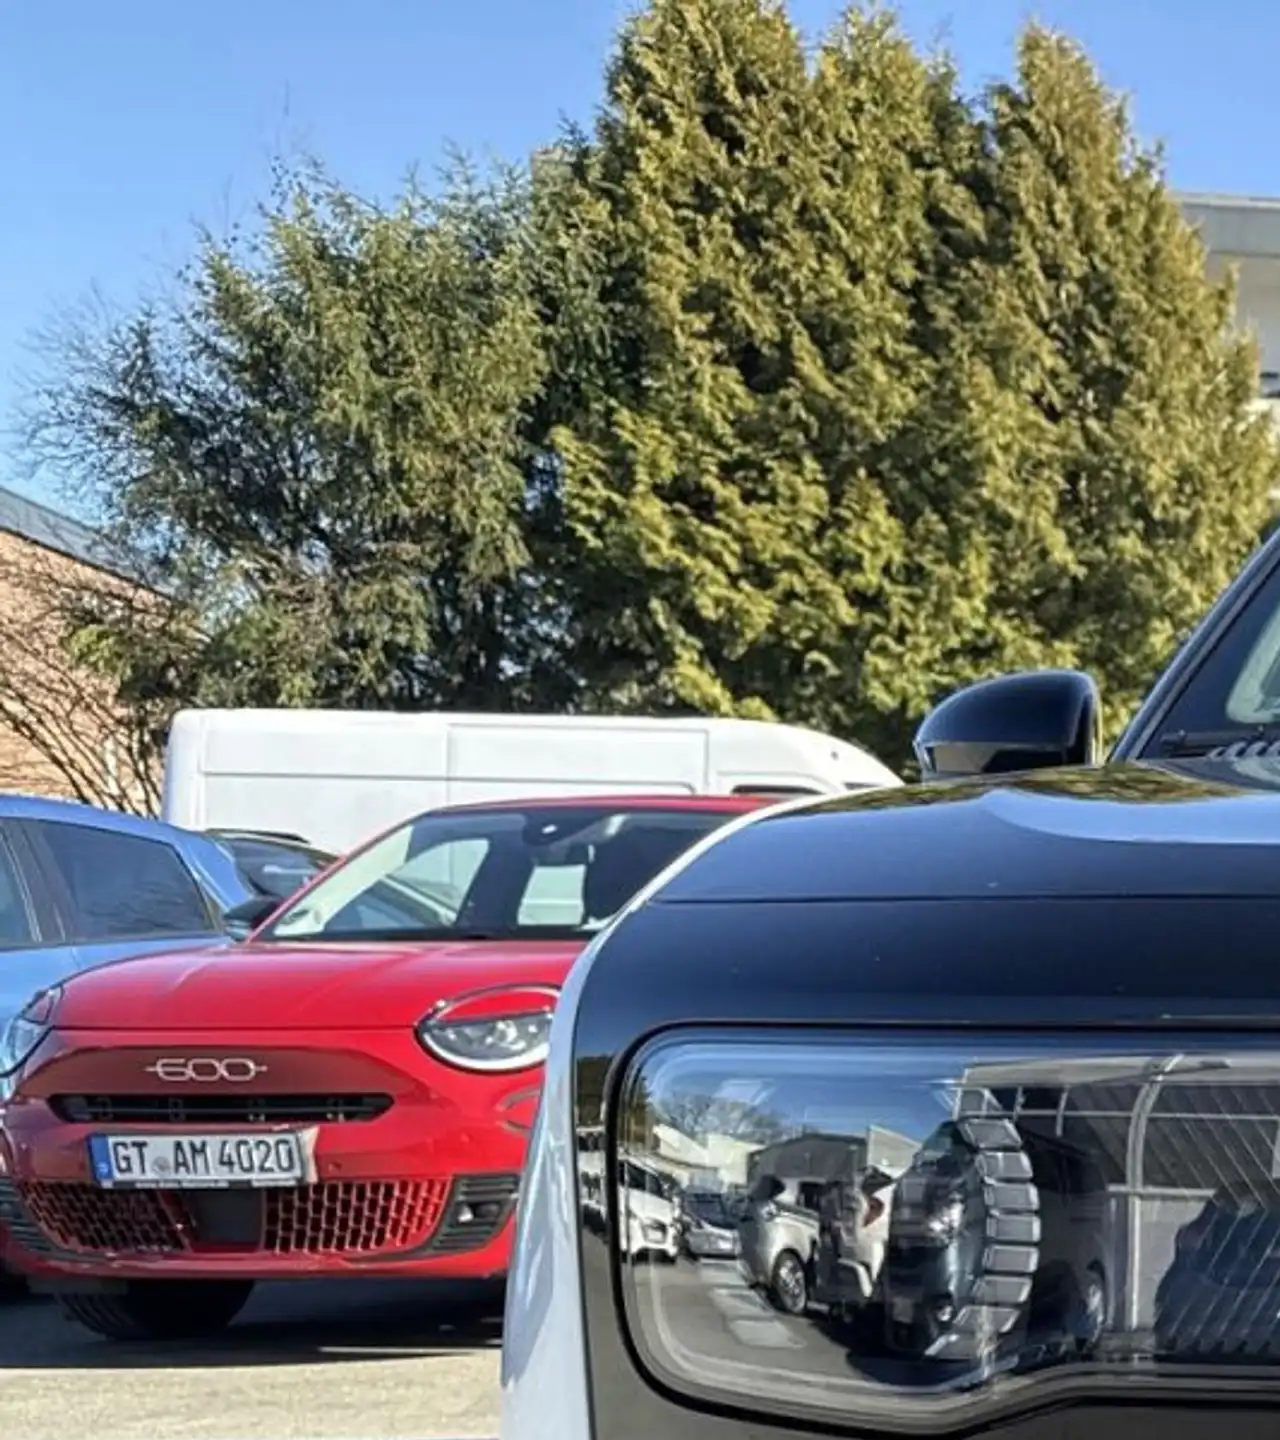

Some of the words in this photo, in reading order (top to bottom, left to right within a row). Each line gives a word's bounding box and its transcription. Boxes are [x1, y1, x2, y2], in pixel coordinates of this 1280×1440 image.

[155, 1057, 256, 1081] 600
[112, 1140, 148, 1174] GT
[173, 1140, 210, 1175] AM
[218, 1138, 296, 1174] 4020
